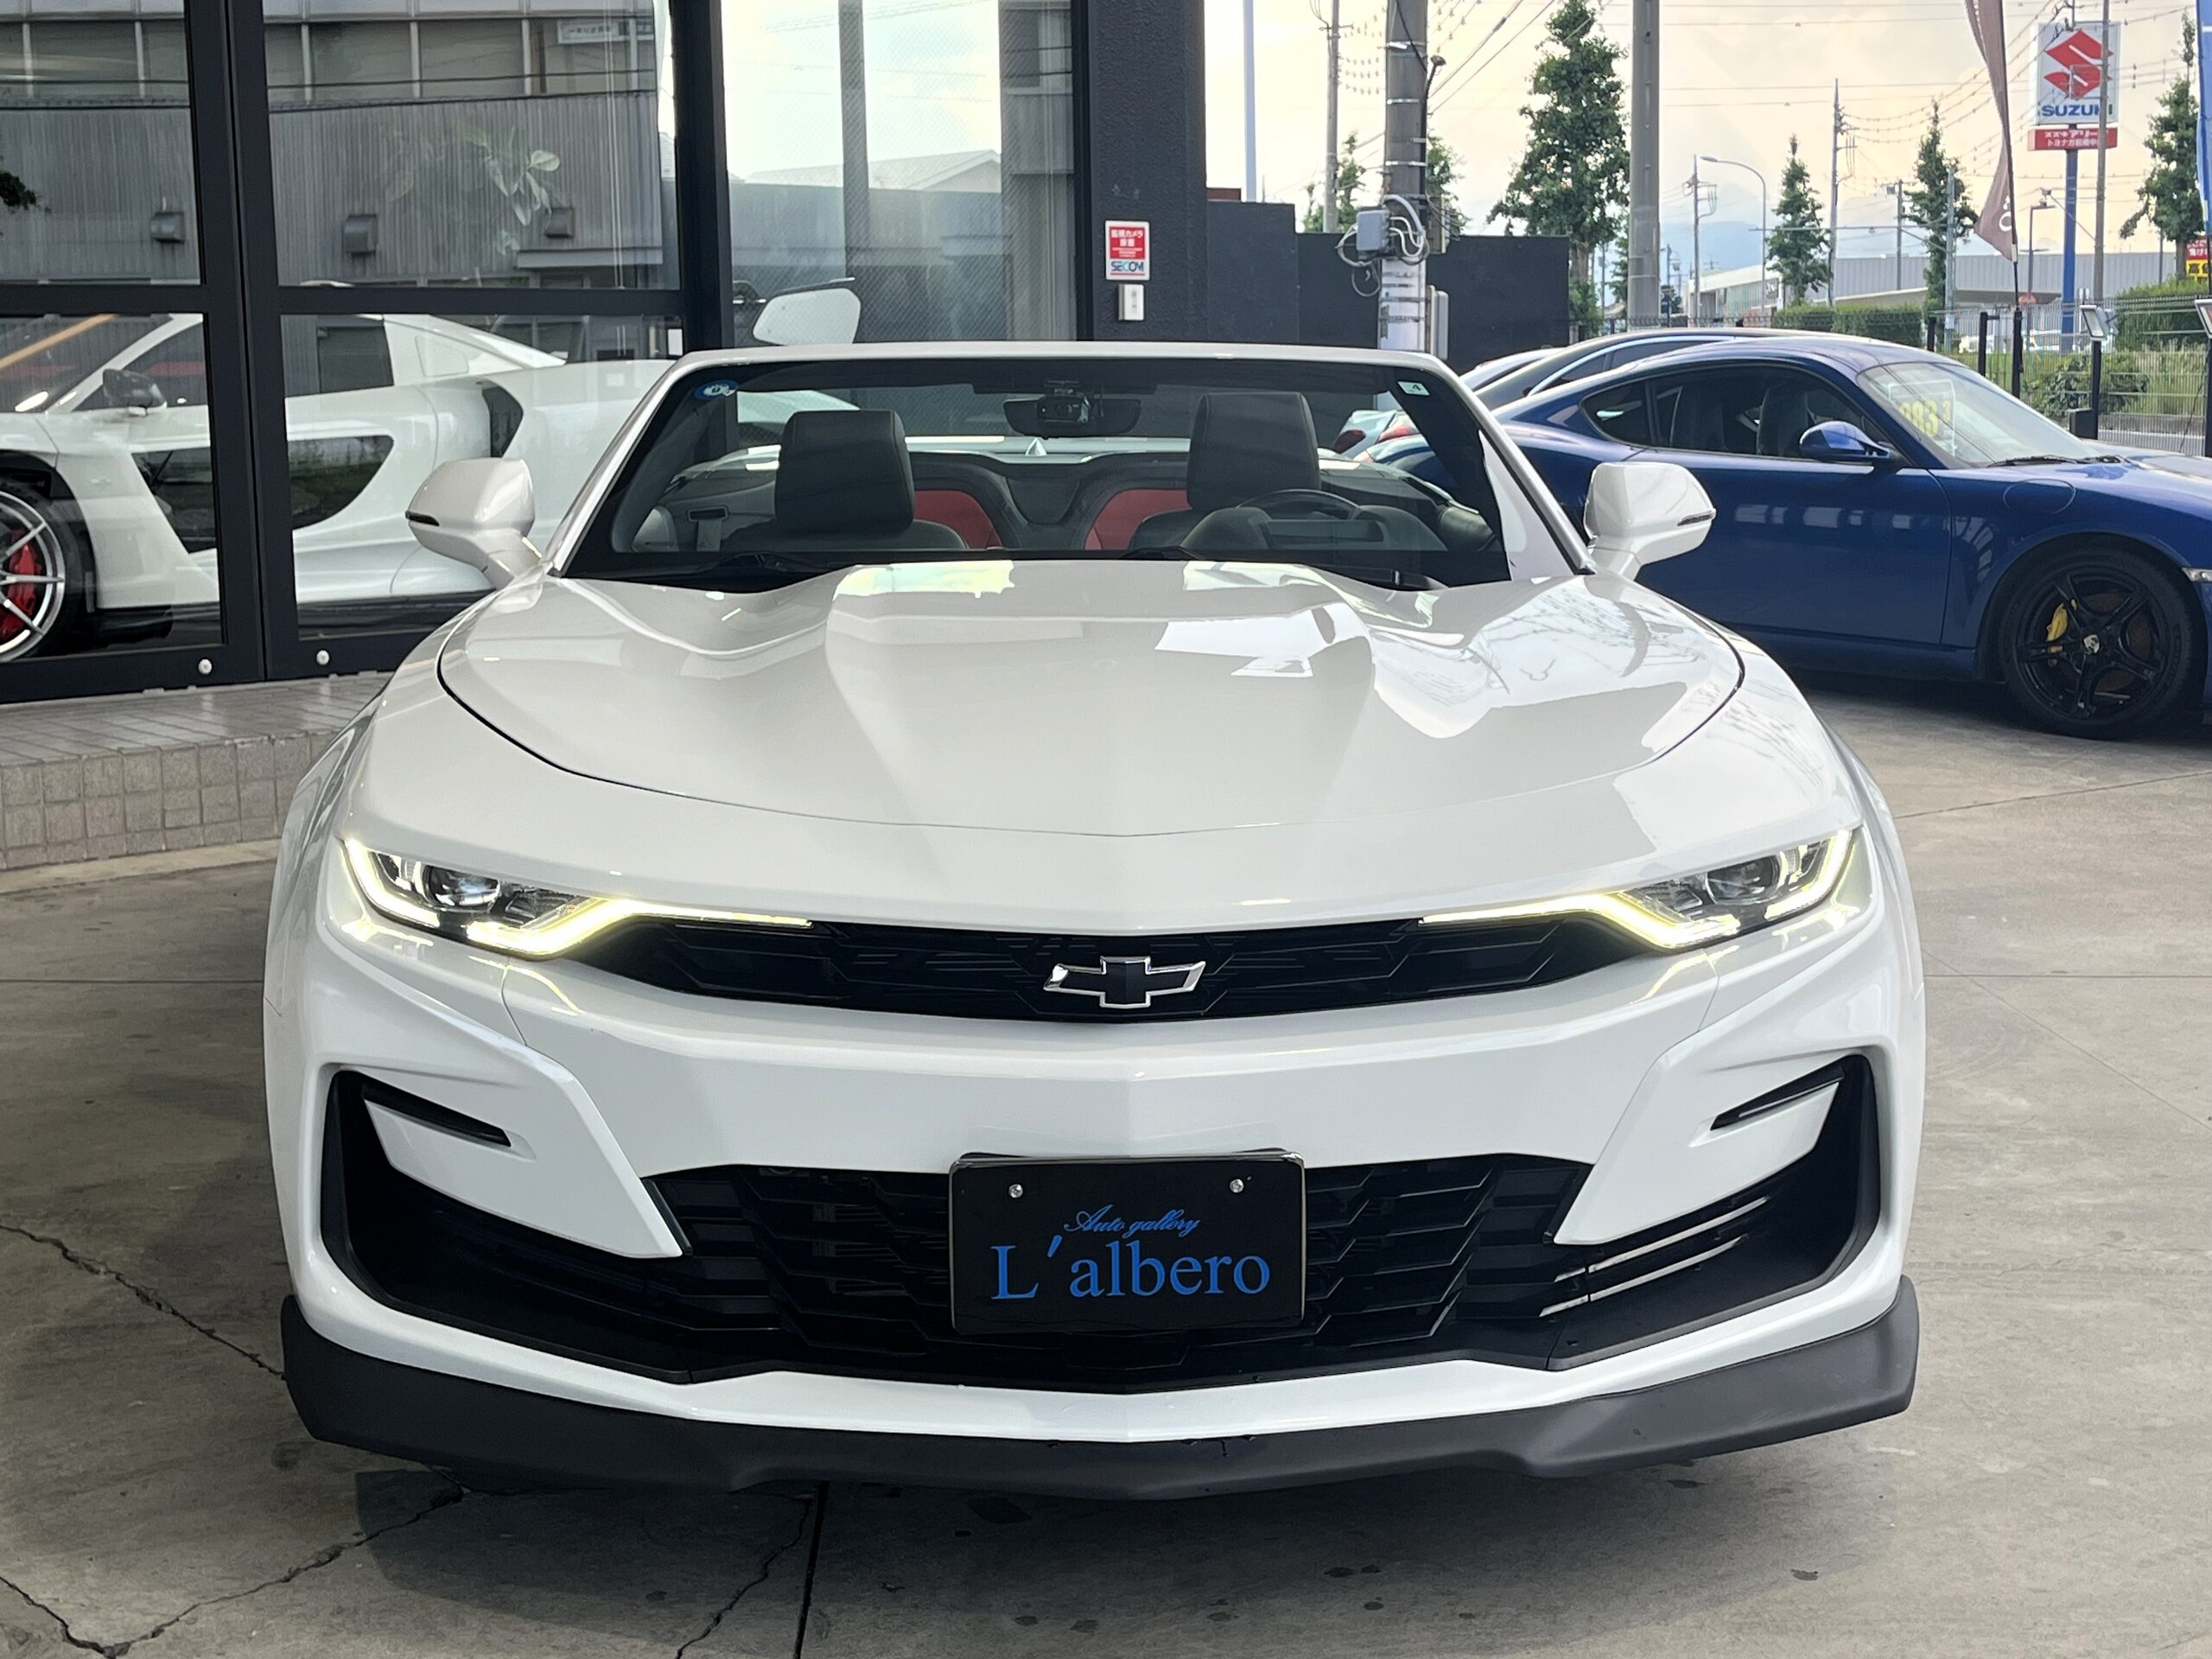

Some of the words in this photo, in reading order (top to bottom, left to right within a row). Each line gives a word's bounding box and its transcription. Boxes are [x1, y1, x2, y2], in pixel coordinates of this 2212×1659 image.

[1111, 261, 1144, 271] SECOM
[1064, 1205, 1125, 1232] Auto
[1122, 1209, 1200, 1239] gallery
[990, 1235, 1270, 1300] L'albero
